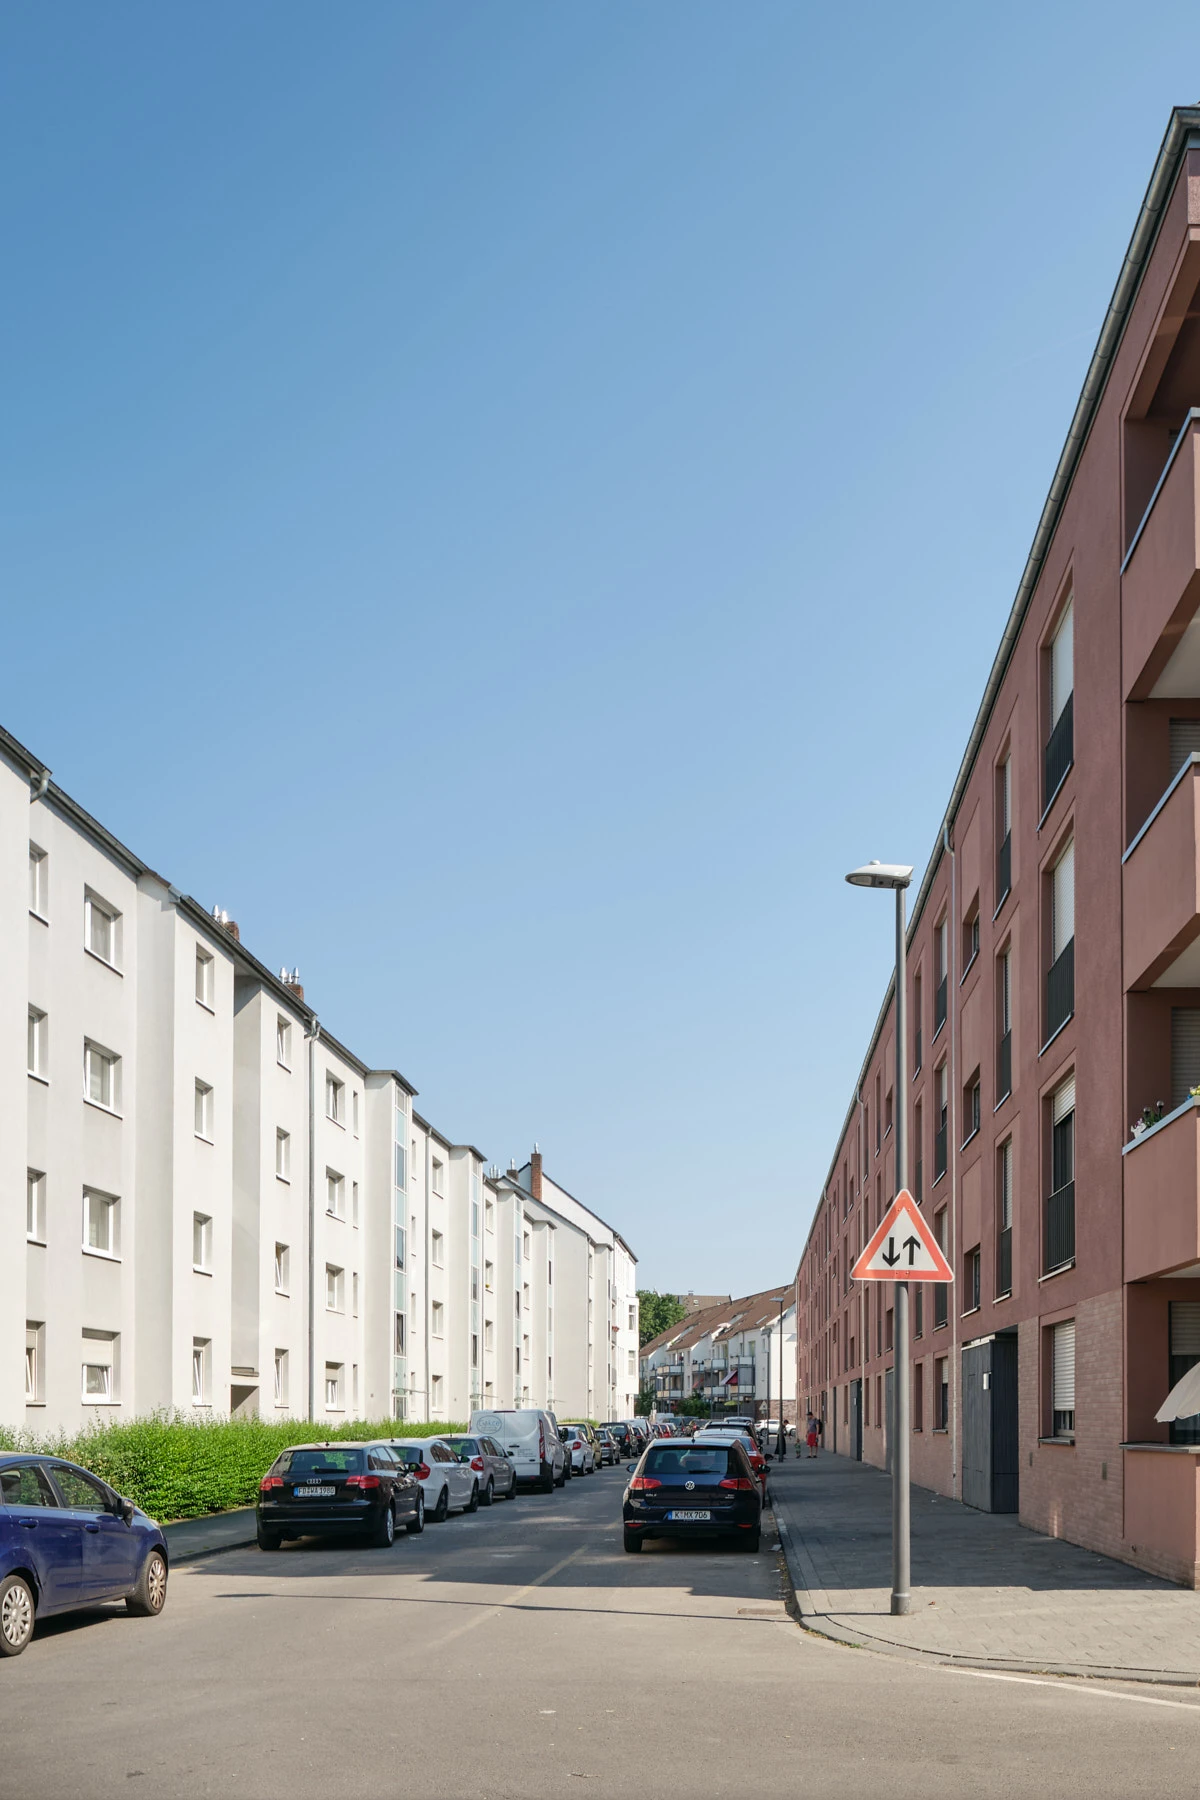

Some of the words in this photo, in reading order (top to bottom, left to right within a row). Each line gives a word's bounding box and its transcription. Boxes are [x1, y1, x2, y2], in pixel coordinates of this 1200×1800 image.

[674, 1511, 680, 1519] K
[683, 1511, 693, 1519] MX
[694, 1511, 708, 1519] 706
